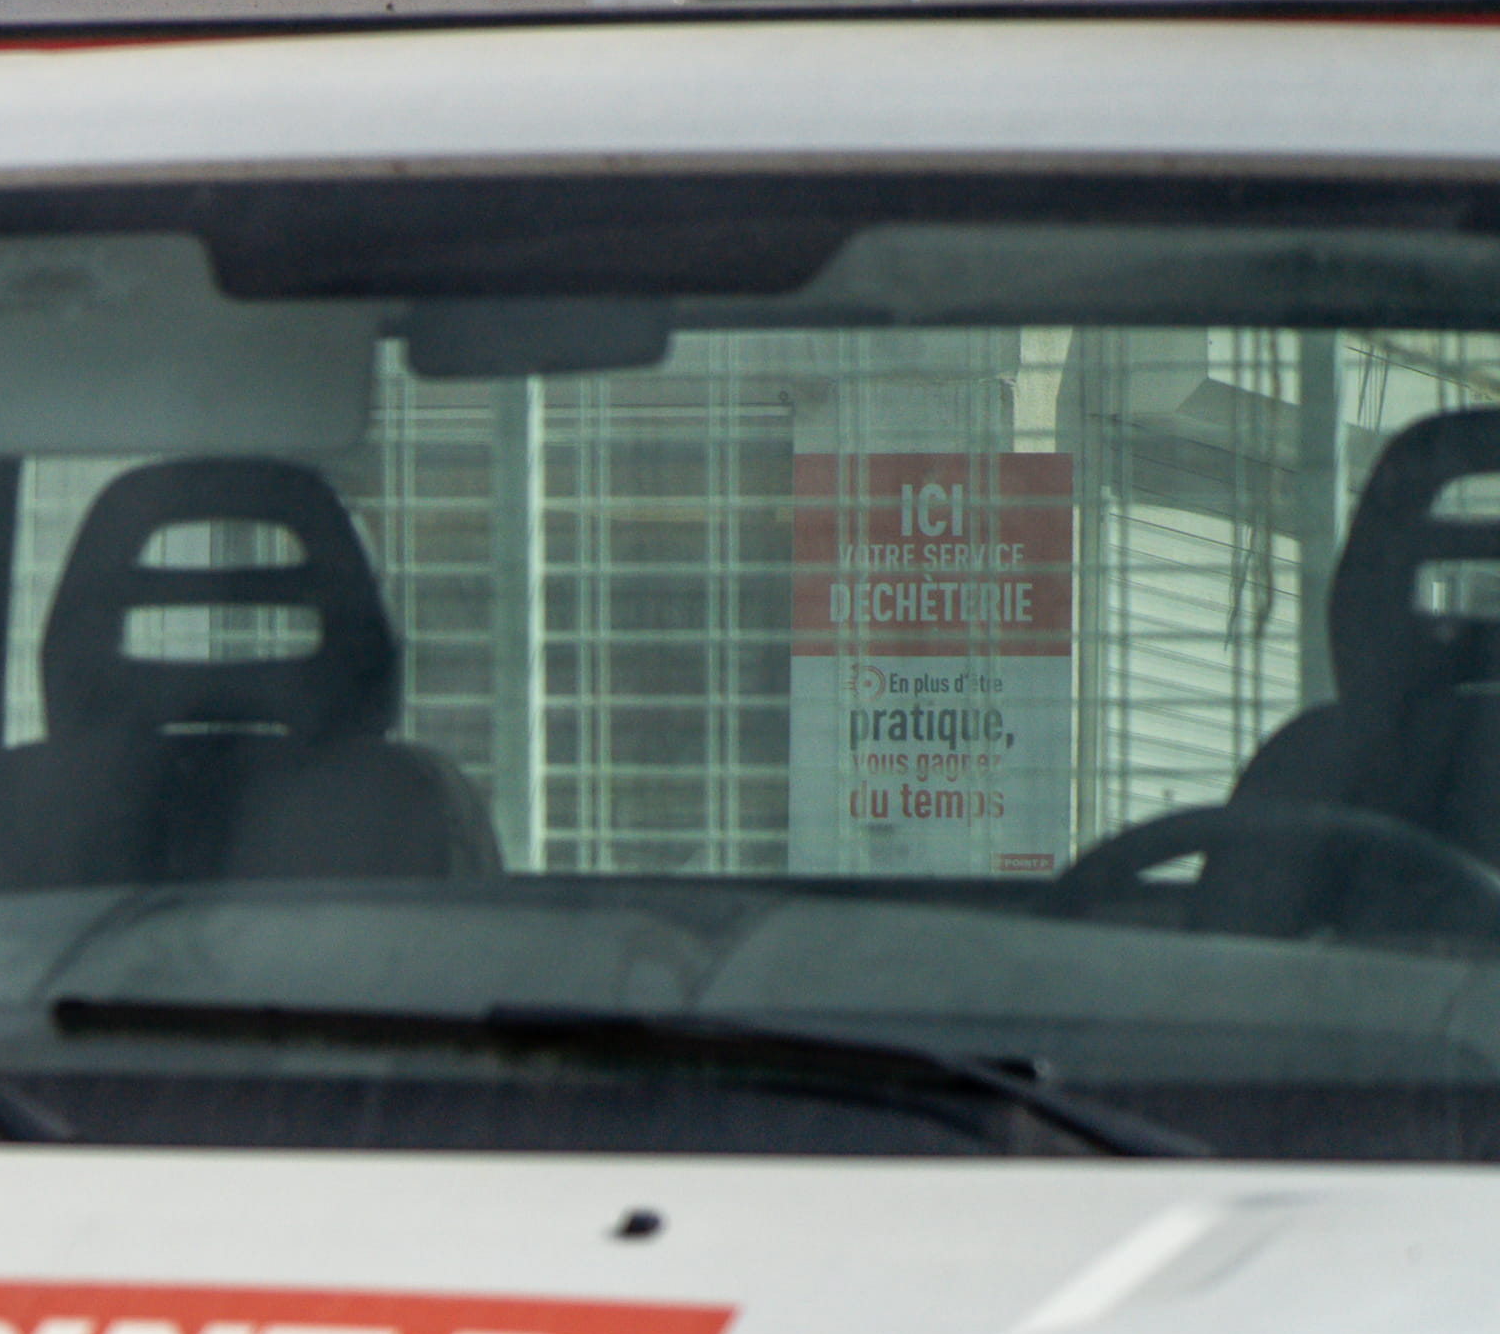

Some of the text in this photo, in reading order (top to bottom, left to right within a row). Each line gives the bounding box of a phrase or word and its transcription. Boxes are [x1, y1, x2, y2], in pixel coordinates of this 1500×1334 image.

[901, 482, 963, 537] ICI
[838, 543, 1025, 573] VOTRE SERVICE
[889, 673, 909, 694] En
[914, 673, 950, 697] plus
[850, 702, 1015, 751] pratique,
[852, 753, 908, 775] vous
[850, 780, 1005, 828] du temps
